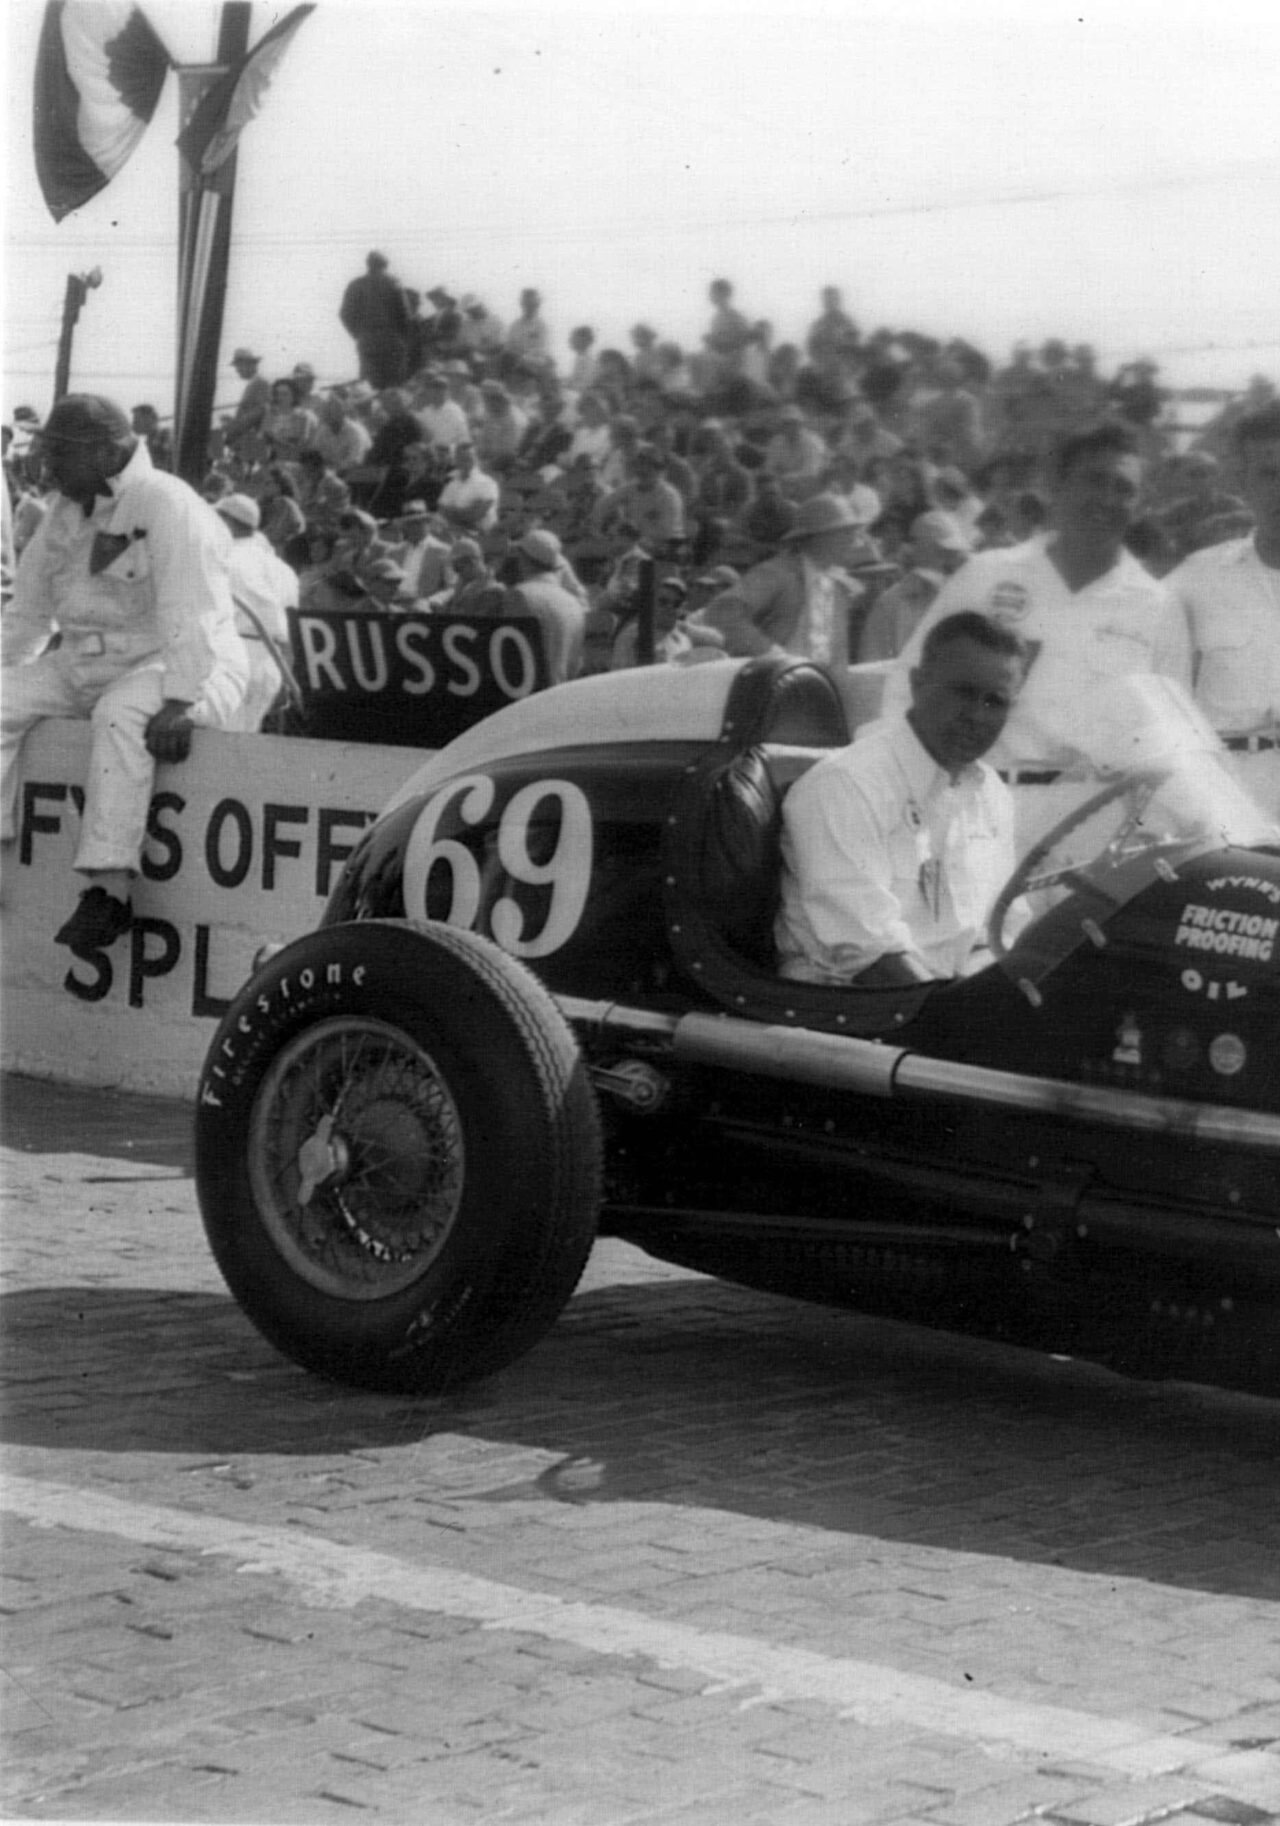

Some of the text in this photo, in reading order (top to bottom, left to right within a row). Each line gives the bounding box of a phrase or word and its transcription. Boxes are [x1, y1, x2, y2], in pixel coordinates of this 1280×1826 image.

[302, 617, 537, 699] RUSSO
[205, 798, 379, 897] OFF
[403, 775, 594, 958] 69
[1175, 925, 1274, 961] PROOFING
[1181, 904, 1280, 939] FRICTION
[63, 917, 234, 1019] SPL
[1181, 969, 1248, 1000] OIL
[203, 961, 366, 1106] Firestone
